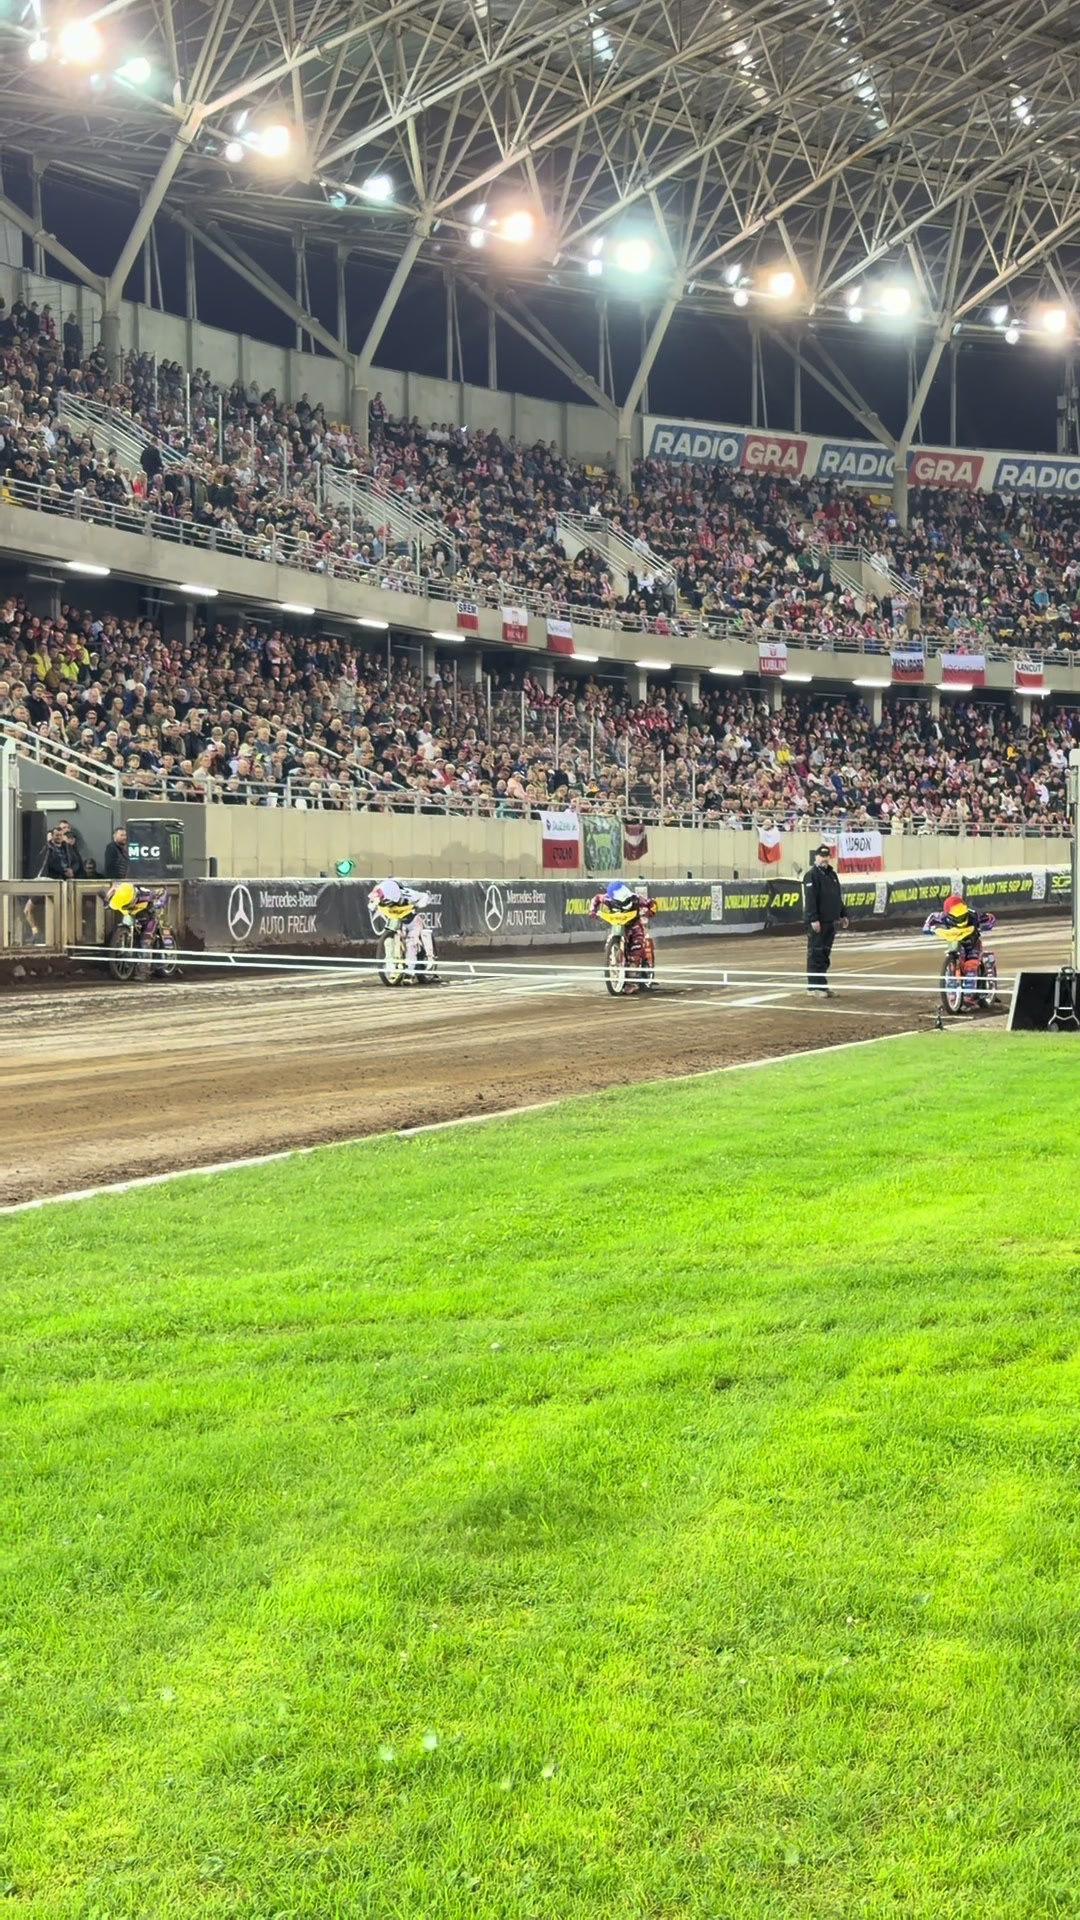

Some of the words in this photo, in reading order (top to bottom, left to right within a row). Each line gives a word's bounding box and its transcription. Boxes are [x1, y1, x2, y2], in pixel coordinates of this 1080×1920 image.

[654, 430, 739, 462] RADIO
[746, 442, 798, 469] GRA
[915, 457, 973, 484] GRA
[760, 659, 787, 671] LUBLIN
[128, 846, 160, 857] MCG
[506, 889, 546, 904] Mercedes-Benz
[966, 882, 996, 897] DOWNLOAD
[996, 881, 1008, 893] THE
[1008, 880, 1020, 892] SGP
[1020, 879, 1032, 891] APP
[259, 891, 317, 908] Mercedes-Benz
[770, 892, 799, 908] APP
[259, 916, 285, 935] AUTO
[287, 914, 317, 933] FRELIK
[506, 910, 523, 926] AUTO
[525, 909, 546, 925] FRELIK
